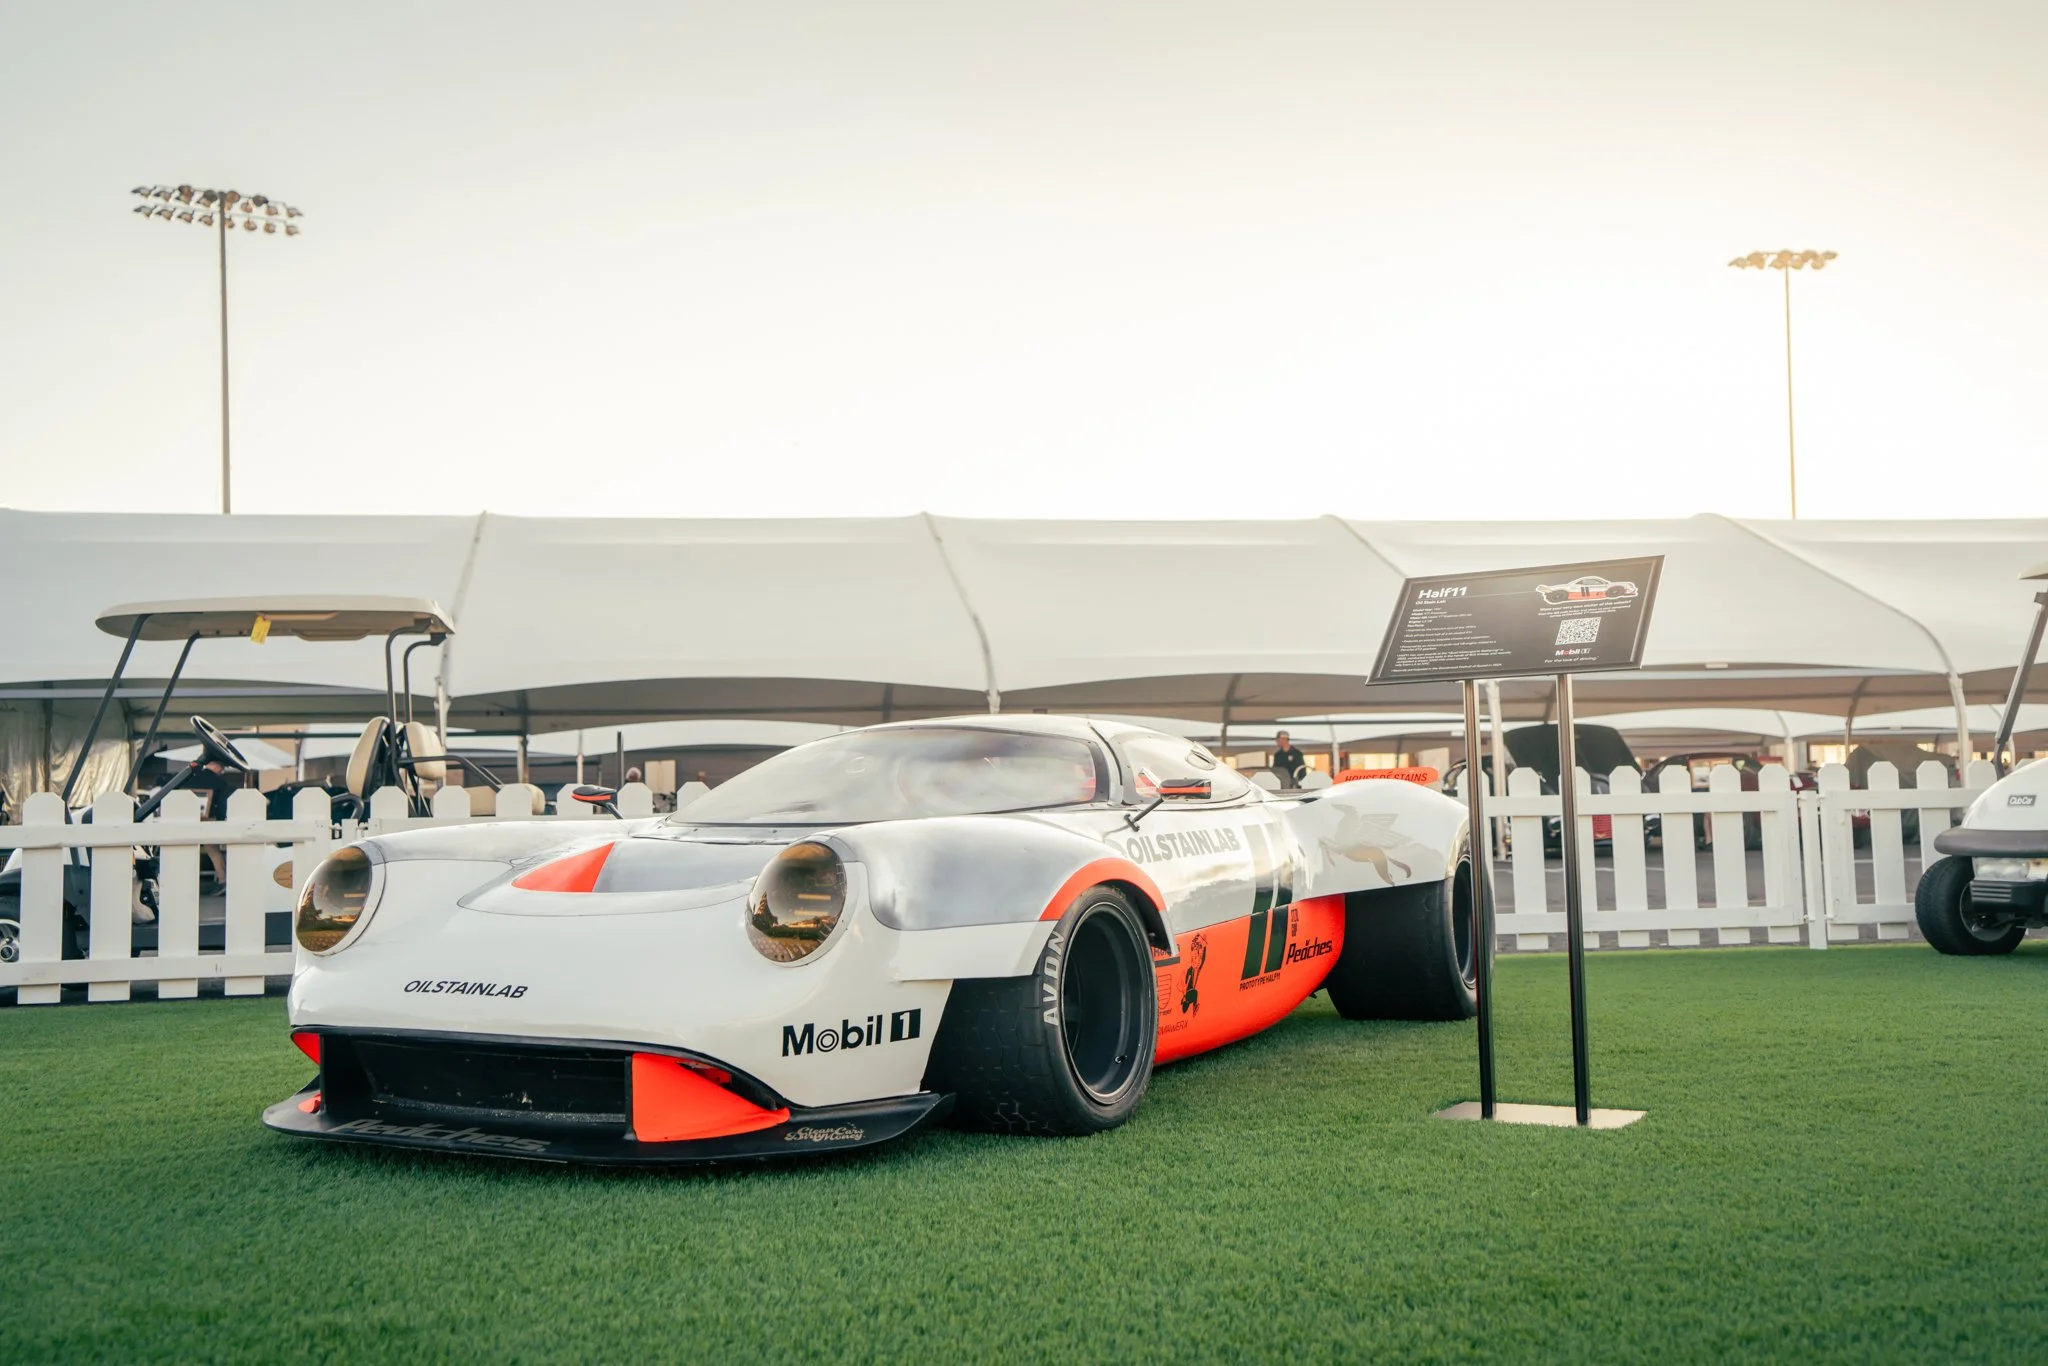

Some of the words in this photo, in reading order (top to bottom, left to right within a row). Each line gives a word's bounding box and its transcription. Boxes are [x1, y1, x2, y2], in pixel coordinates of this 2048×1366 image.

[1418, 586, 1468, 599] Half11
[1555, 648, 1581, 656] Mobil
[1126, 827, 1241, 864] OILSTAINLAB
[1042, 930, 1065, 1026] AVON
[1239, 976, 1265, 992] PROTOTYPE
[403, 980, 528, 998] OILSTAINLAB
[782, 1014, 883, 1057] Mobil
[797, 1126, 834, 1135] Clean
[834, 1126, 865, 1135] Cars
